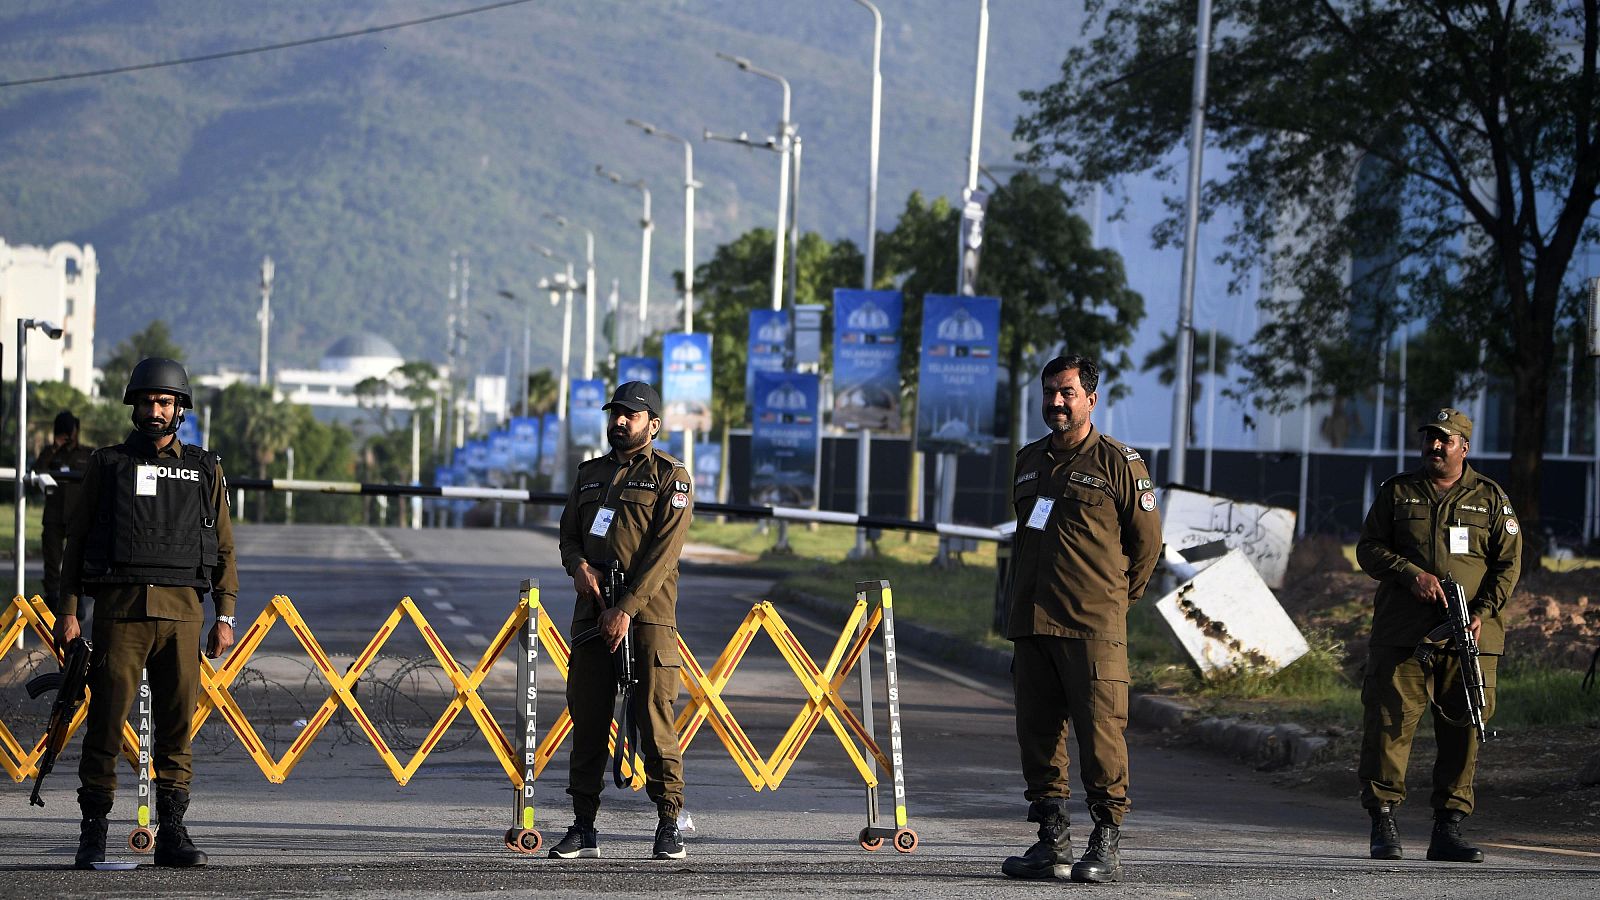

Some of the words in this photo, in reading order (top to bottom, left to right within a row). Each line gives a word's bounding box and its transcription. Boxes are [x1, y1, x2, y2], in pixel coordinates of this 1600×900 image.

[928, 363, 990, 374] ISLAMABAD
[943, 374, 975, 384] TALKS
[157, 466, 200, 481] OLICE
[527, 617, 538, 663] ITP
[885, 618, 895, 664] ITP
[138, 667, 150, 797] ISLAMBAD
[525, 670, 537, 798] ISLAMBAD
[888, 676, 905, 798] ISLAMBAD
